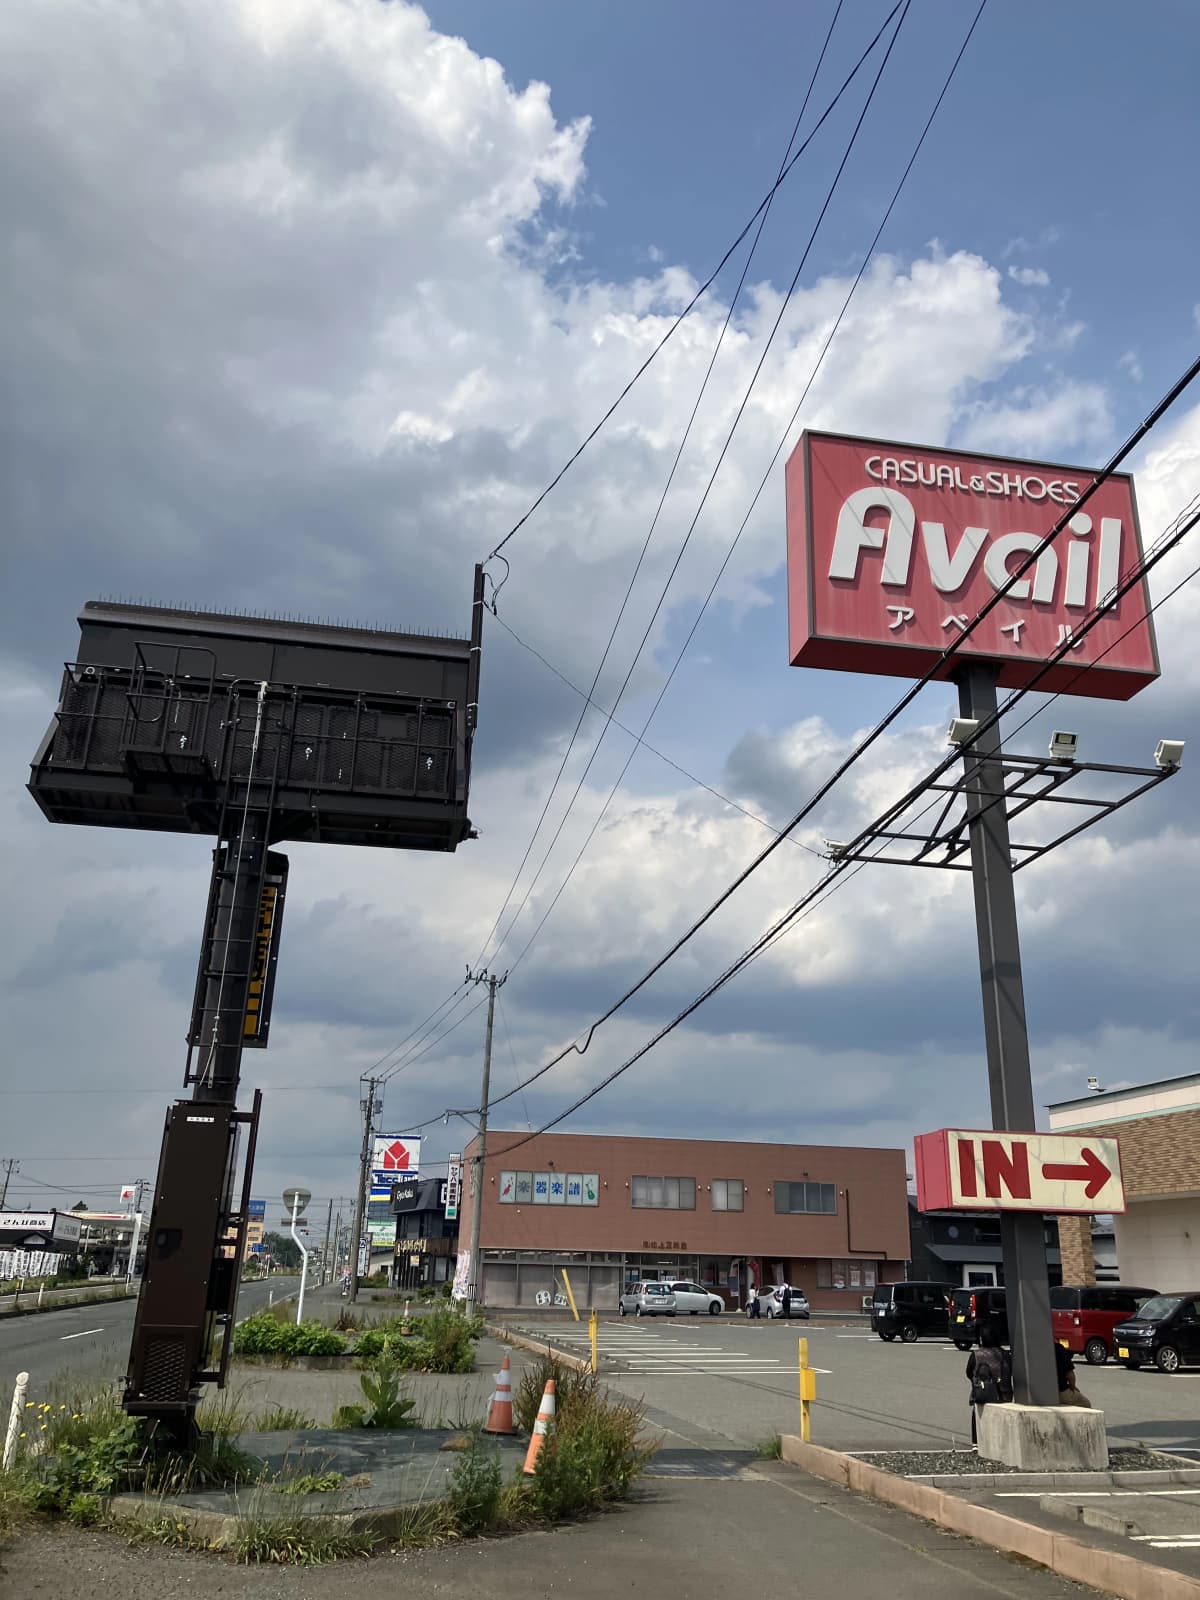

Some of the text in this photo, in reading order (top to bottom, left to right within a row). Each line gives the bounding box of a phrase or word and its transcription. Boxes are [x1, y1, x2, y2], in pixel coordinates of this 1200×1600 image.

[864, 455, 1081, 504] CASUAL&SHOES
[828, 486, 1122, 611] Avail
[886, 604, 1084, 650] アベイル
[517, 1180, 581, 1196] 楽器楽譜
[957, 1139, 1032, 1200] IN
